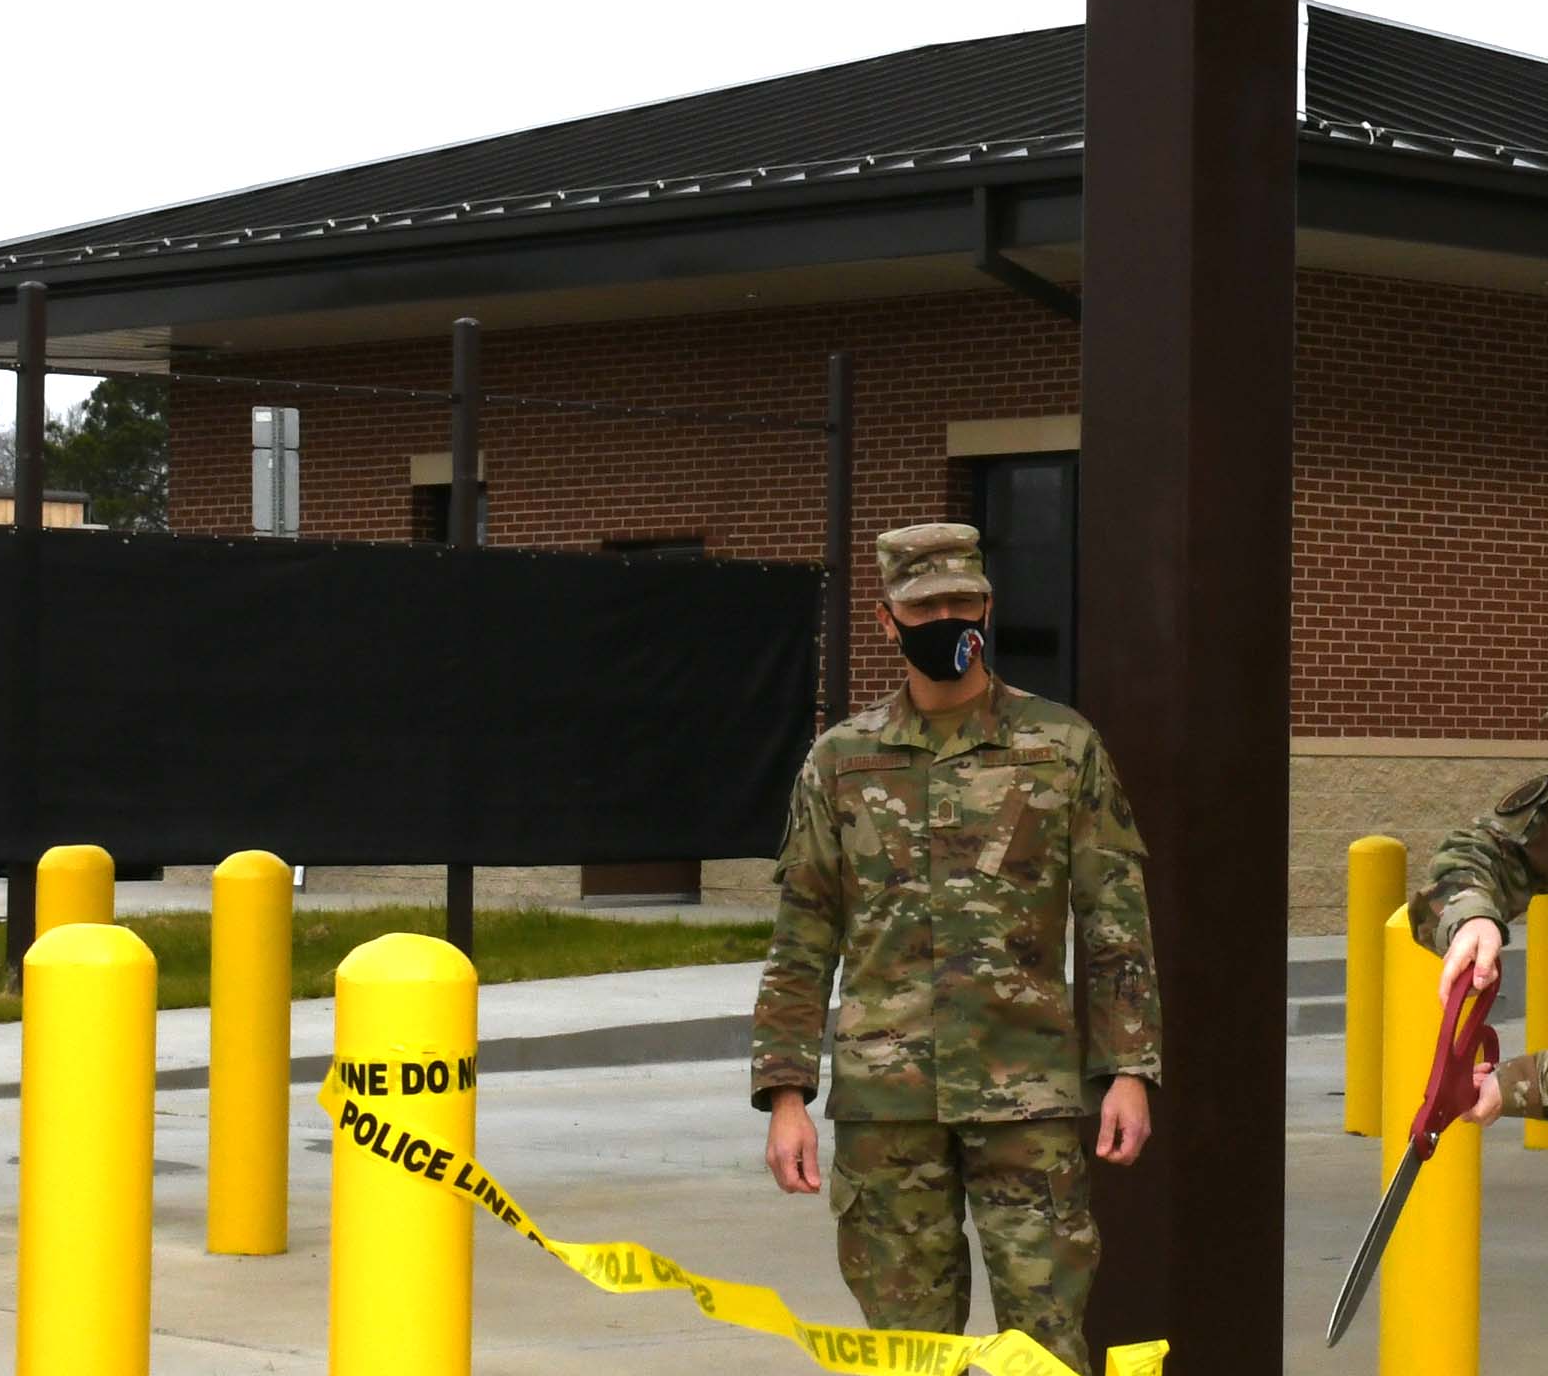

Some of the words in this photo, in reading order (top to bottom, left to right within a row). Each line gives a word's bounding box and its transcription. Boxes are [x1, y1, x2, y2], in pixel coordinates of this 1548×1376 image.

[402, 1060, 449, 1095] DO
[340, 1100, 454, 1181] POLICE
[453, 1163, 521, 1227] LINE
